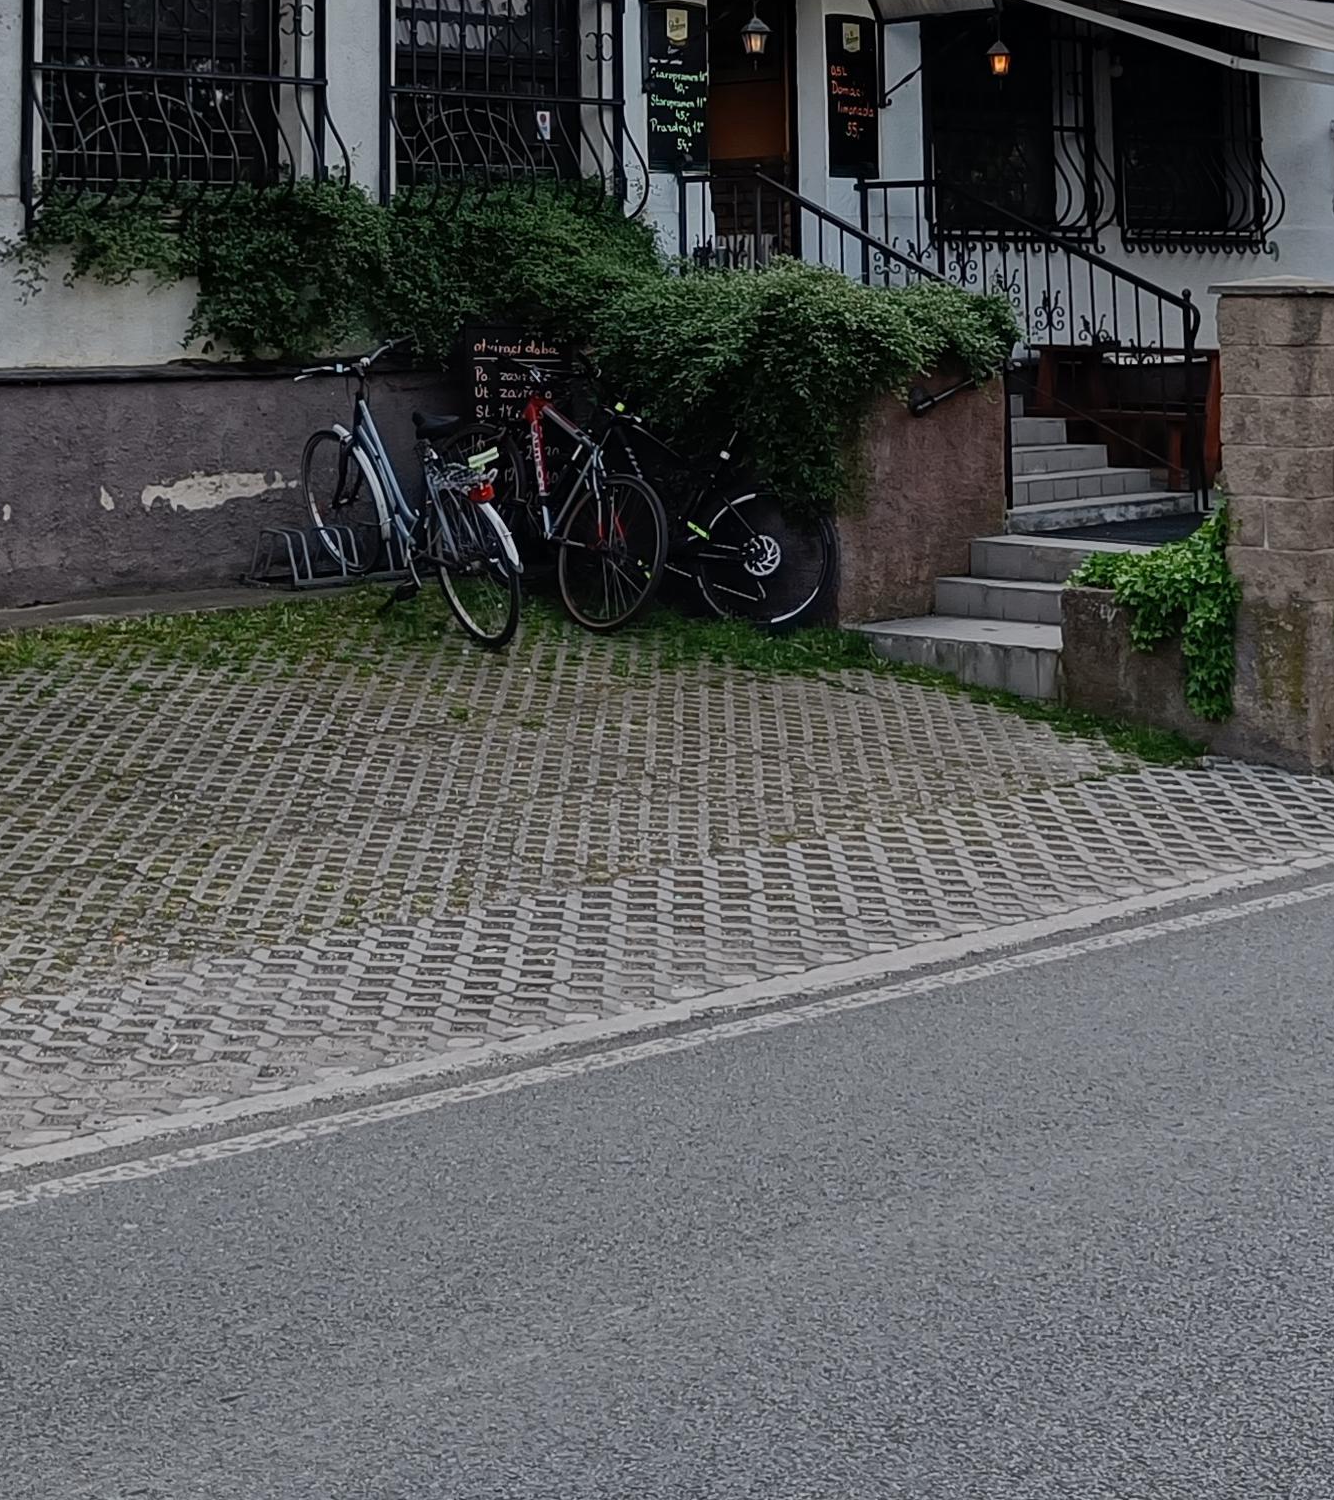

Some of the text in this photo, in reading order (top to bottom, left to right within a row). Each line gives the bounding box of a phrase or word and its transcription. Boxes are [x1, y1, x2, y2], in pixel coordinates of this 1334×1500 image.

[650, 94, 695, 109] Staropramen
[650, 117, 692, 137] Prazdroj
[524, 339, 560, 355] doba
